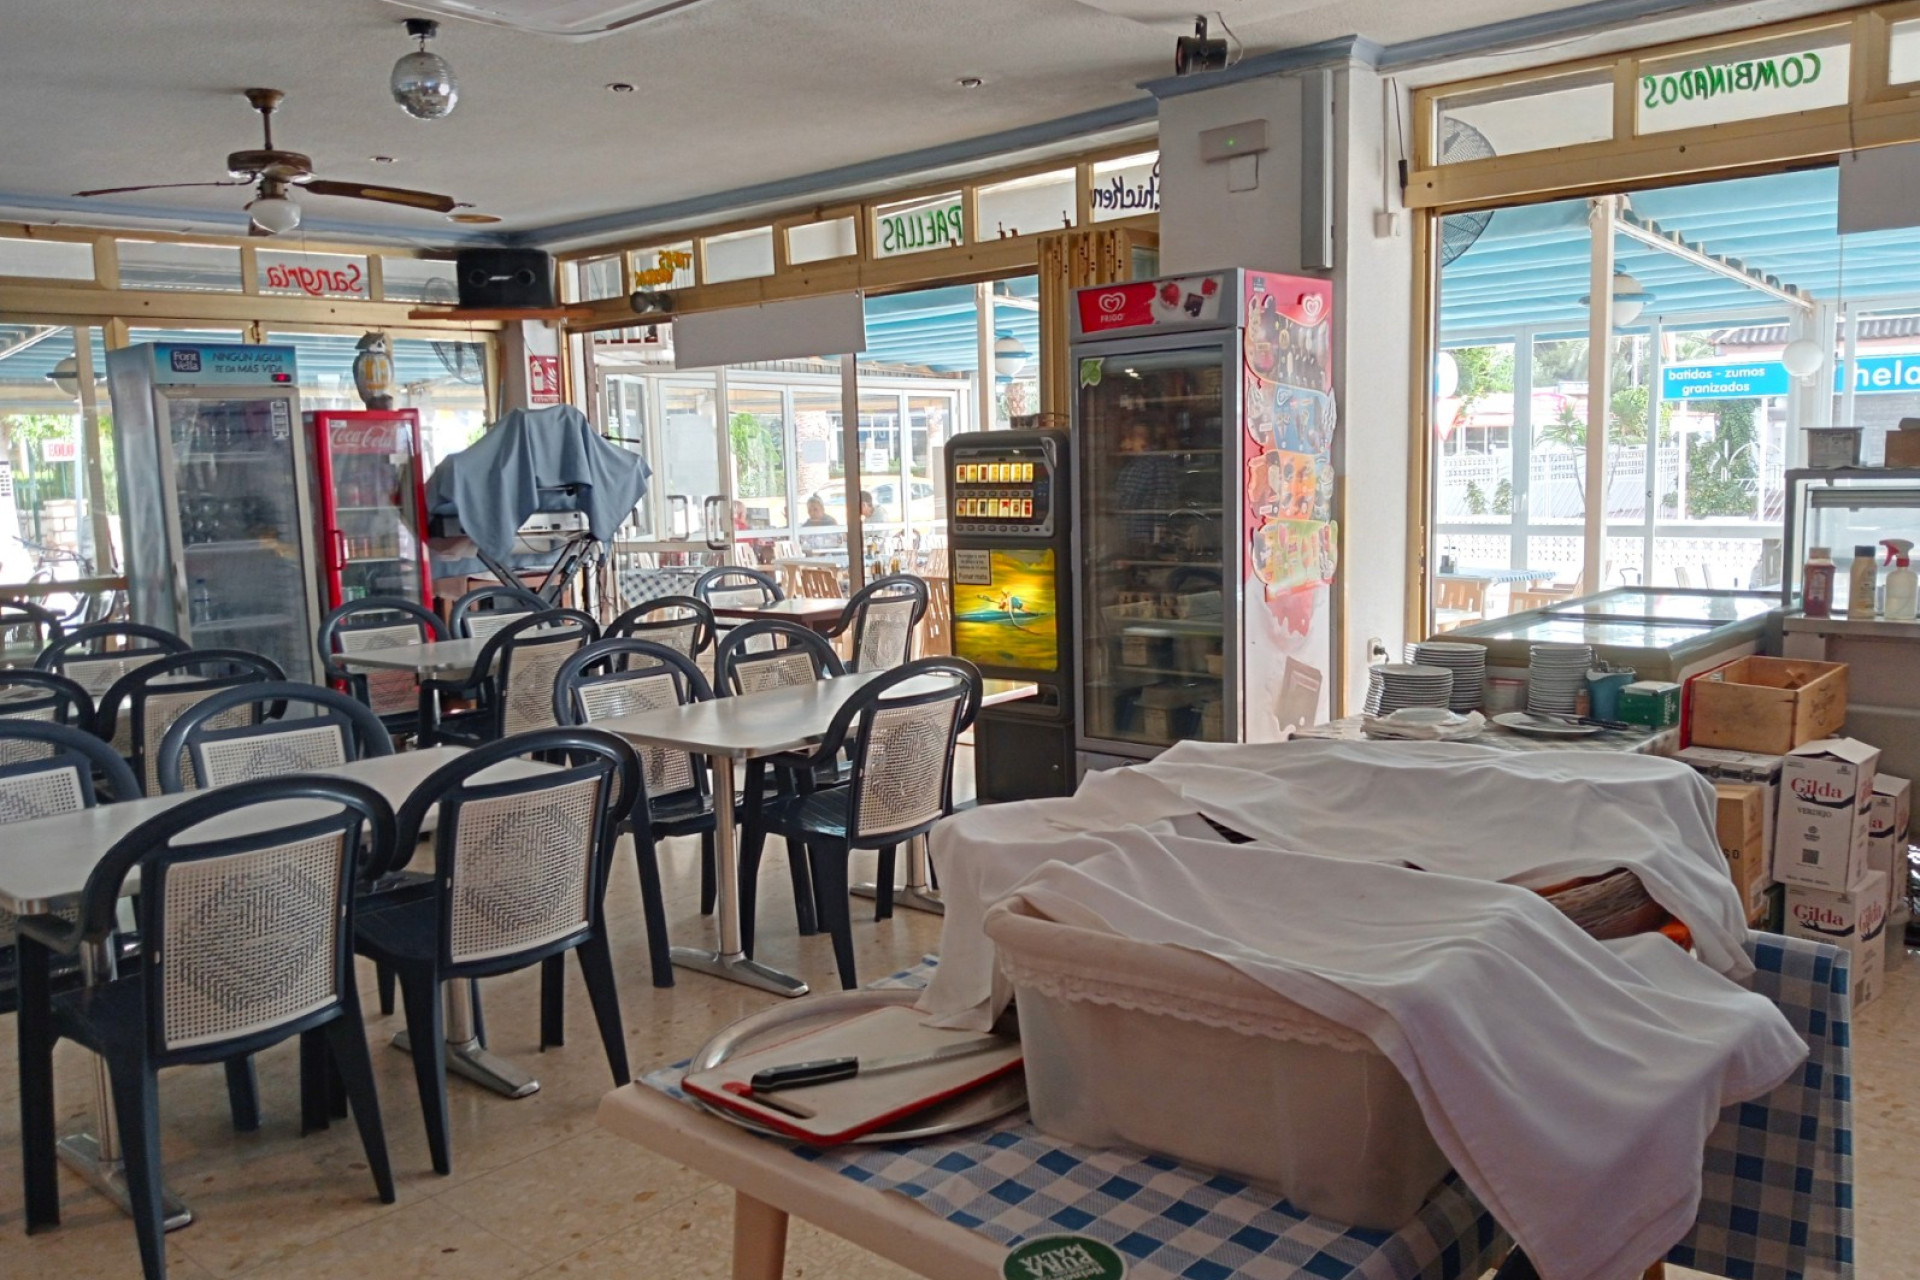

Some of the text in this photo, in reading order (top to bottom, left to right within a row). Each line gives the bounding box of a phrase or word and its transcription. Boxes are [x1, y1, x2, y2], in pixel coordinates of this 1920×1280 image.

[173, 352, 198, 361] Font
[1668, 368, 1713, 380] batidos
[1725, 367, 1765, 378] zumos
[1682, 382, 1750, 397] granizados
[1791, 777, 1843, 799] Gilda
[1794, 903, 1844, 926] Gilda
